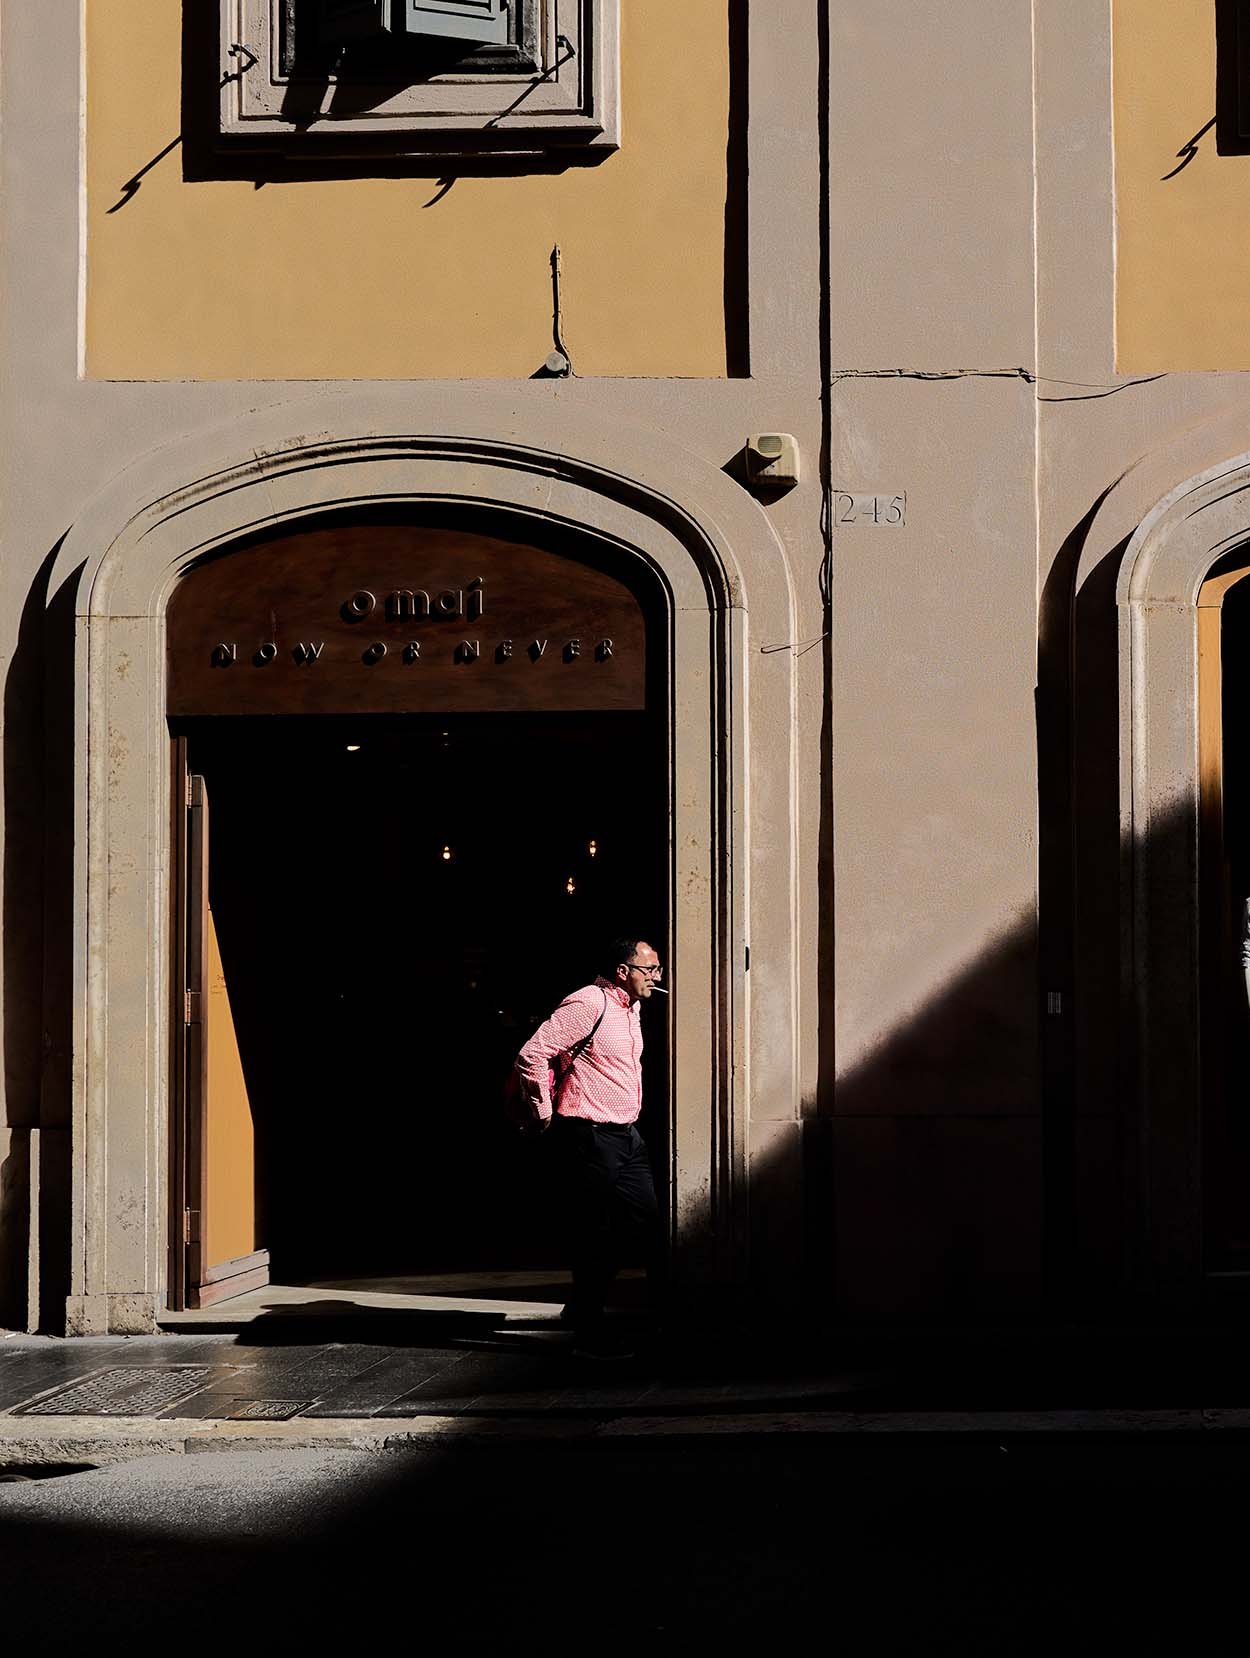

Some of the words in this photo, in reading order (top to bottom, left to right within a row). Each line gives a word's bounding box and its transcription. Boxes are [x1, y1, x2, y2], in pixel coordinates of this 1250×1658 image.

[839, 494, 903, 523] 245
[215, 642, 325, 662] NOW
[367, 640, 421, 659] OR
[461, 639, 616, 658] NEVER
